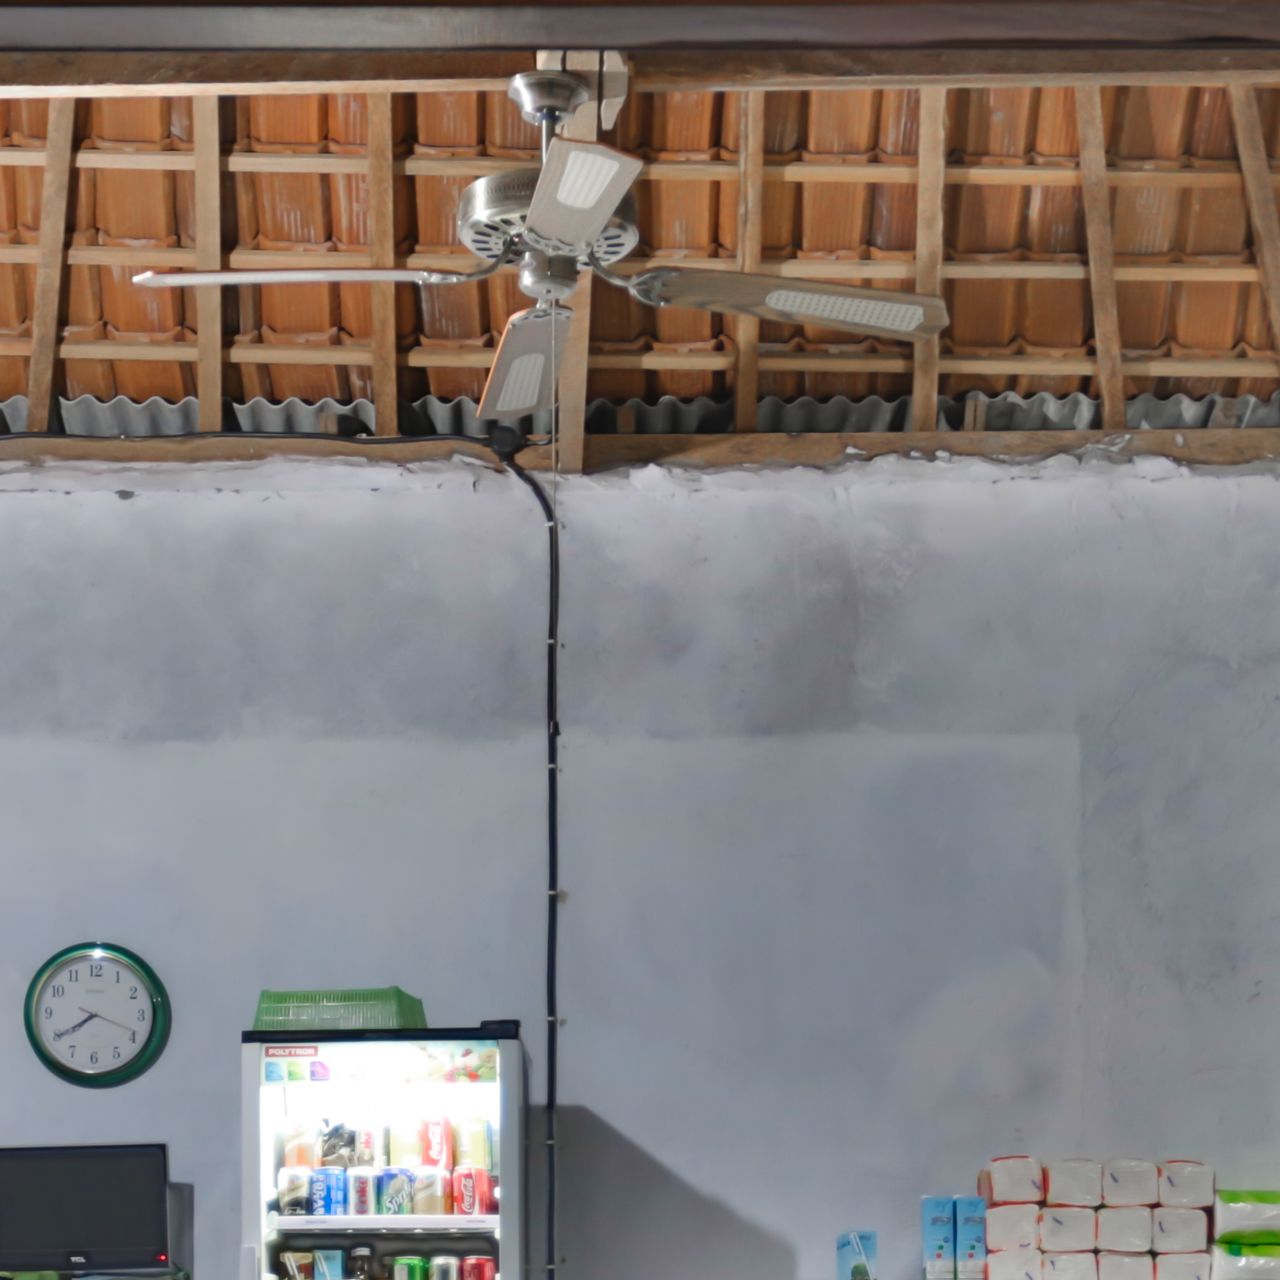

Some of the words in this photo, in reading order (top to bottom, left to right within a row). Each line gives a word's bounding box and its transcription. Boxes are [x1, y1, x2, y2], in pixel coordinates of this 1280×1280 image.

[68, 969, 79, 982] 11
[89, 964, 103, 977] 12
[115, 971, 120, 983] 1
[52, 985, 64, 998] 10
[129, 986, 138, 1000] 2
[44, 1007, 53, 1020] 9
[137, 1009, 146, 1022] 3
[128, 1031, 136, 1044] 4
[69, 1045, 76, 1058] 7
[90, 1051, 98, 1064] 6
[112, 1046, 120, 1059] 5
